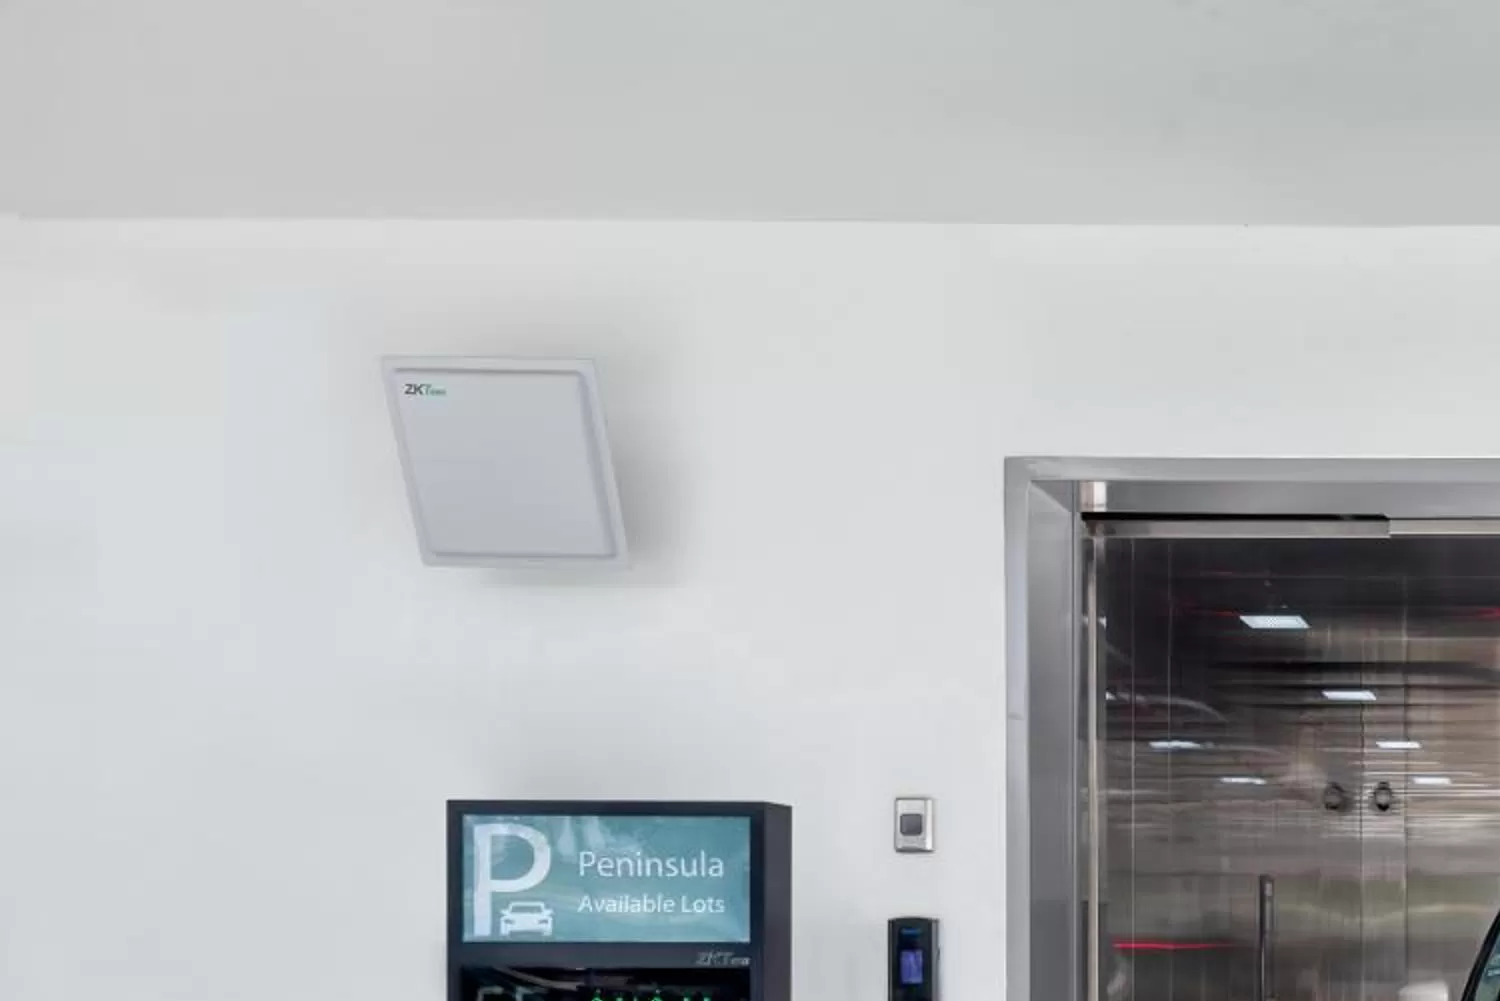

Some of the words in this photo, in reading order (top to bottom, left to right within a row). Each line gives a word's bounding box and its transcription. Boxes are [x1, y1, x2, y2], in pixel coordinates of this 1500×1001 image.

[578, 850, 725, 878] Peninsula
[577, 896, 676, 914] Available
[681, 896, 726, 914] Lots
